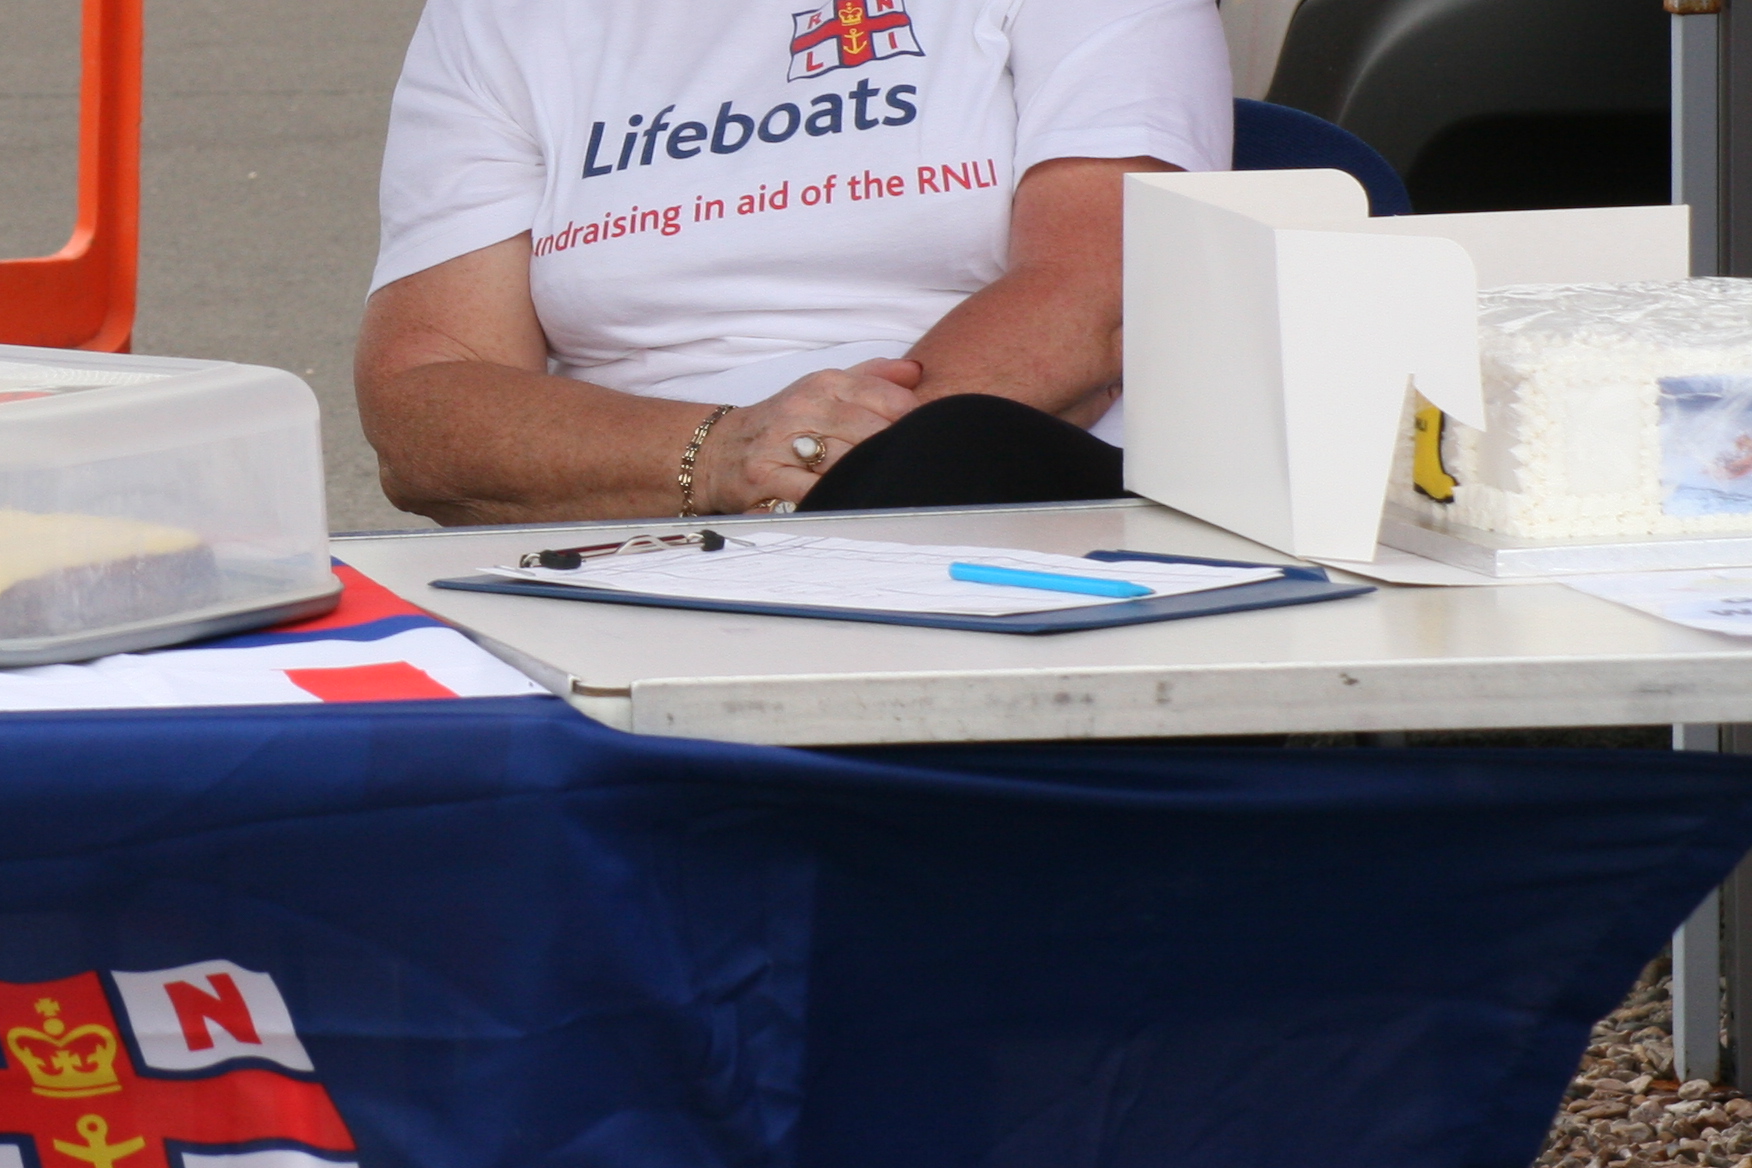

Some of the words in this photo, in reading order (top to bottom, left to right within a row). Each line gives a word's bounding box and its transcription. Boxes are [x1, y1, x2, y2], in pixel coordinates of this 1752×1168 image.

[805, 52, 824, 72] L
[582, 77, 918, 179] Lifeboats
[695, 194, 725, 222] in
[737, 181, 789, 216] aid
[801, 174, 838, 206] of
[847, 170, 905, 202] the
[917, 159, 998, 195] RNLI
[165, 972, 262, 1052] N
